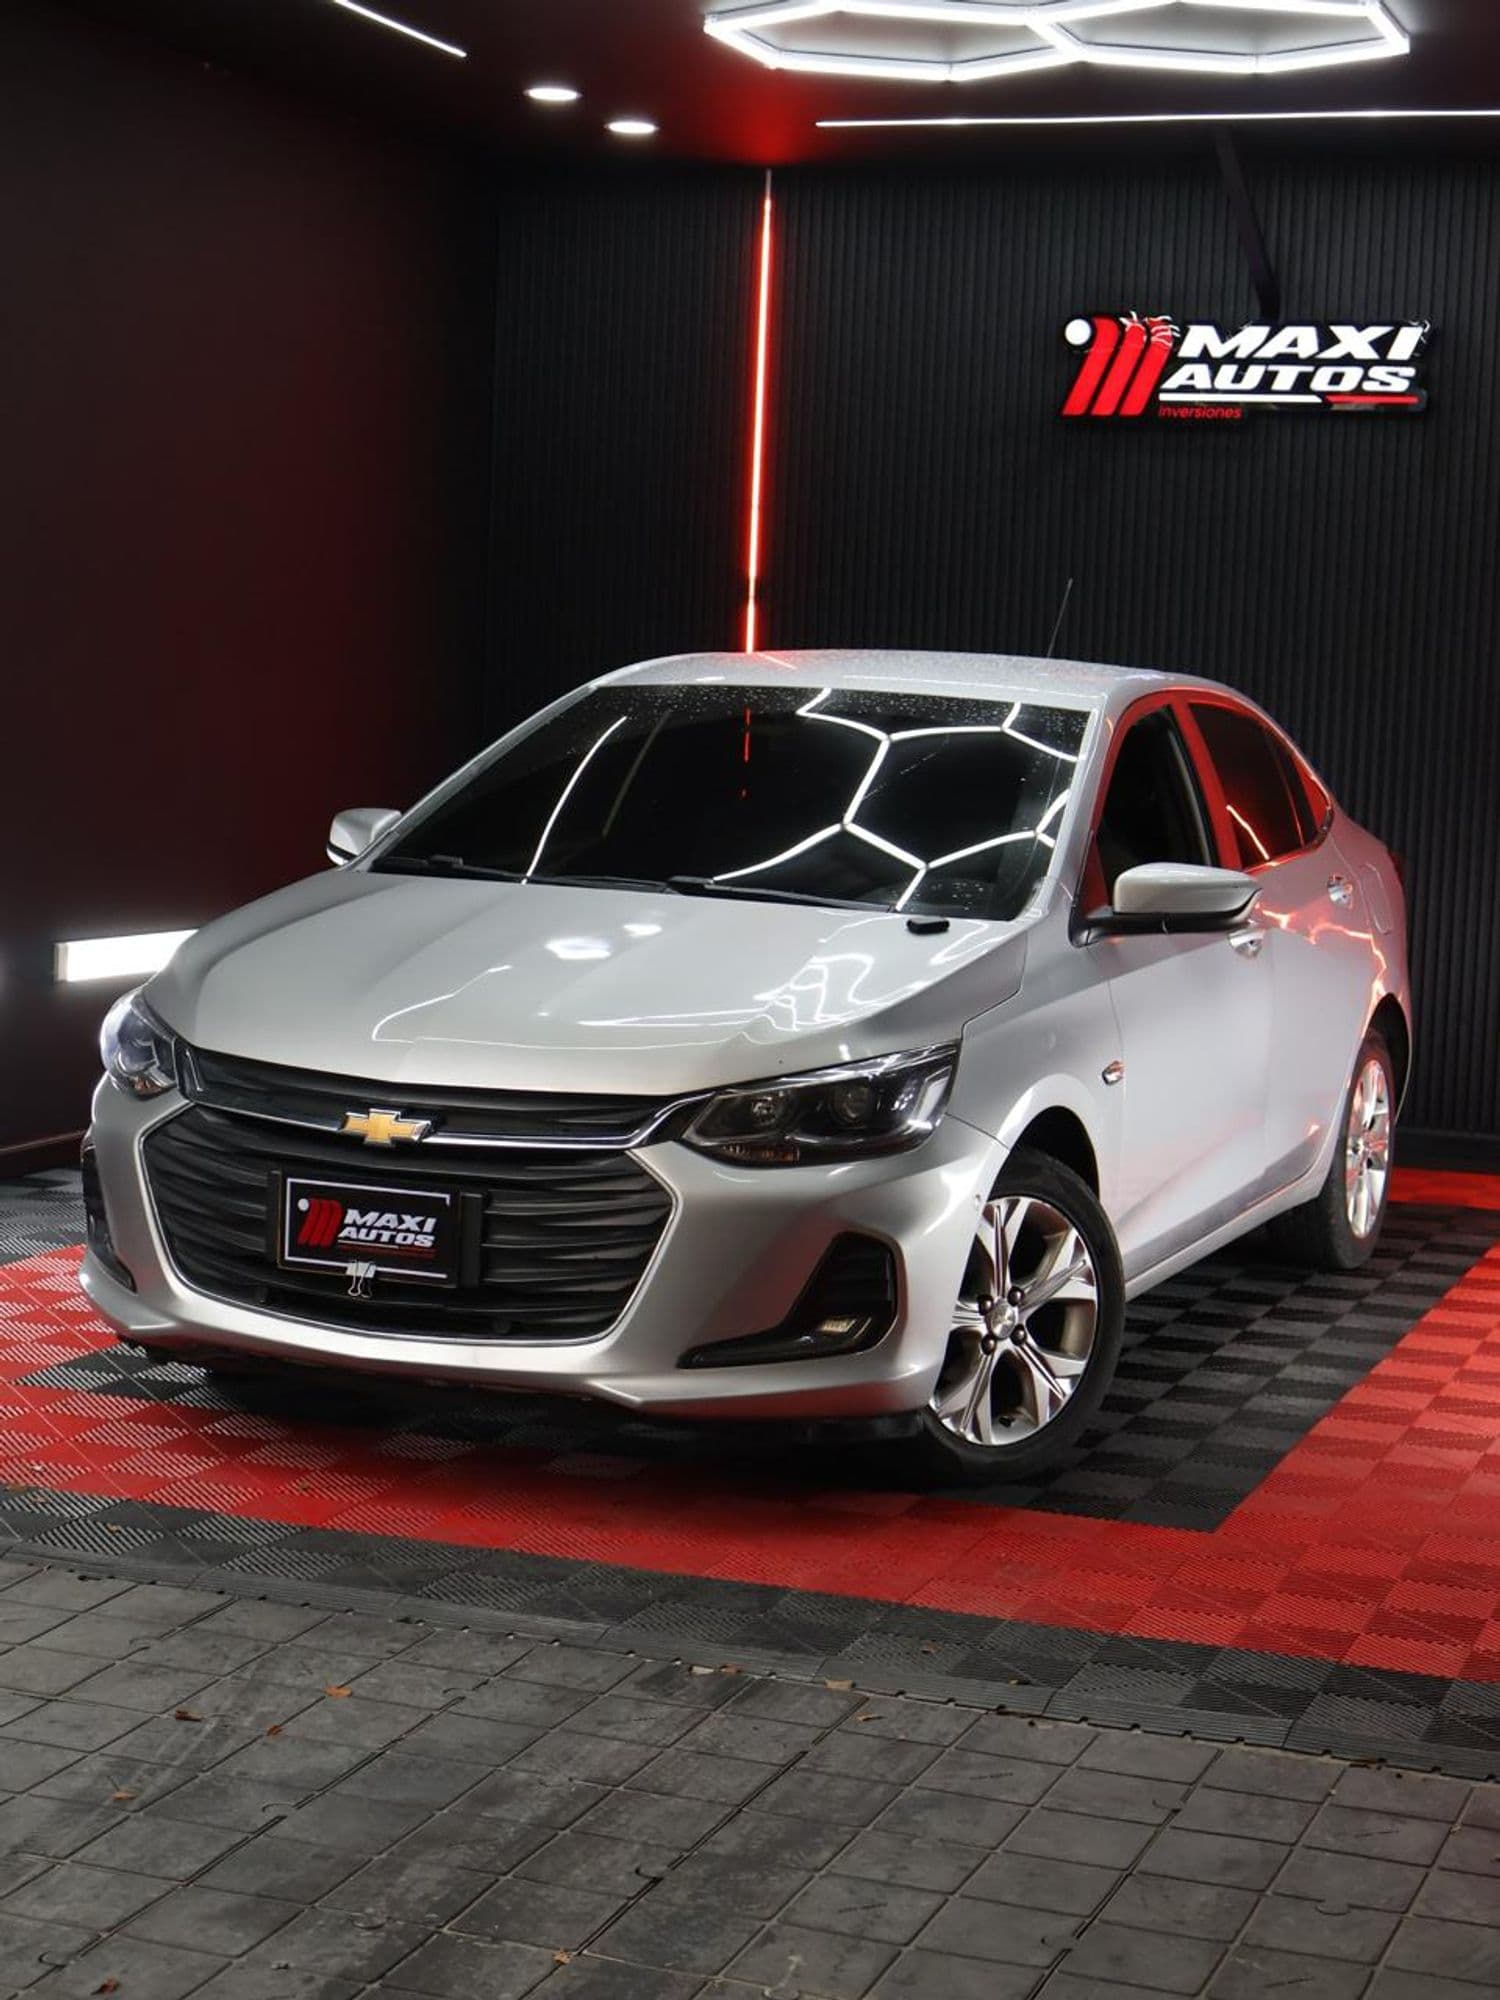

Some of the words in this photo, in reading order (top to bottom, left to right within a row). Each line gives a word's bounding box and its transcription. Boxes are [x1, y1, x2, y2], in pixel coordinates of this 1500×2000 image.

[1178, 325, 1424, 359] MAXI
[1160, 364, 1415, 392] AUTOS
[344, 1208, 437, 1233] MAXI
[338, 1226, 436, 1248] AUTOS
